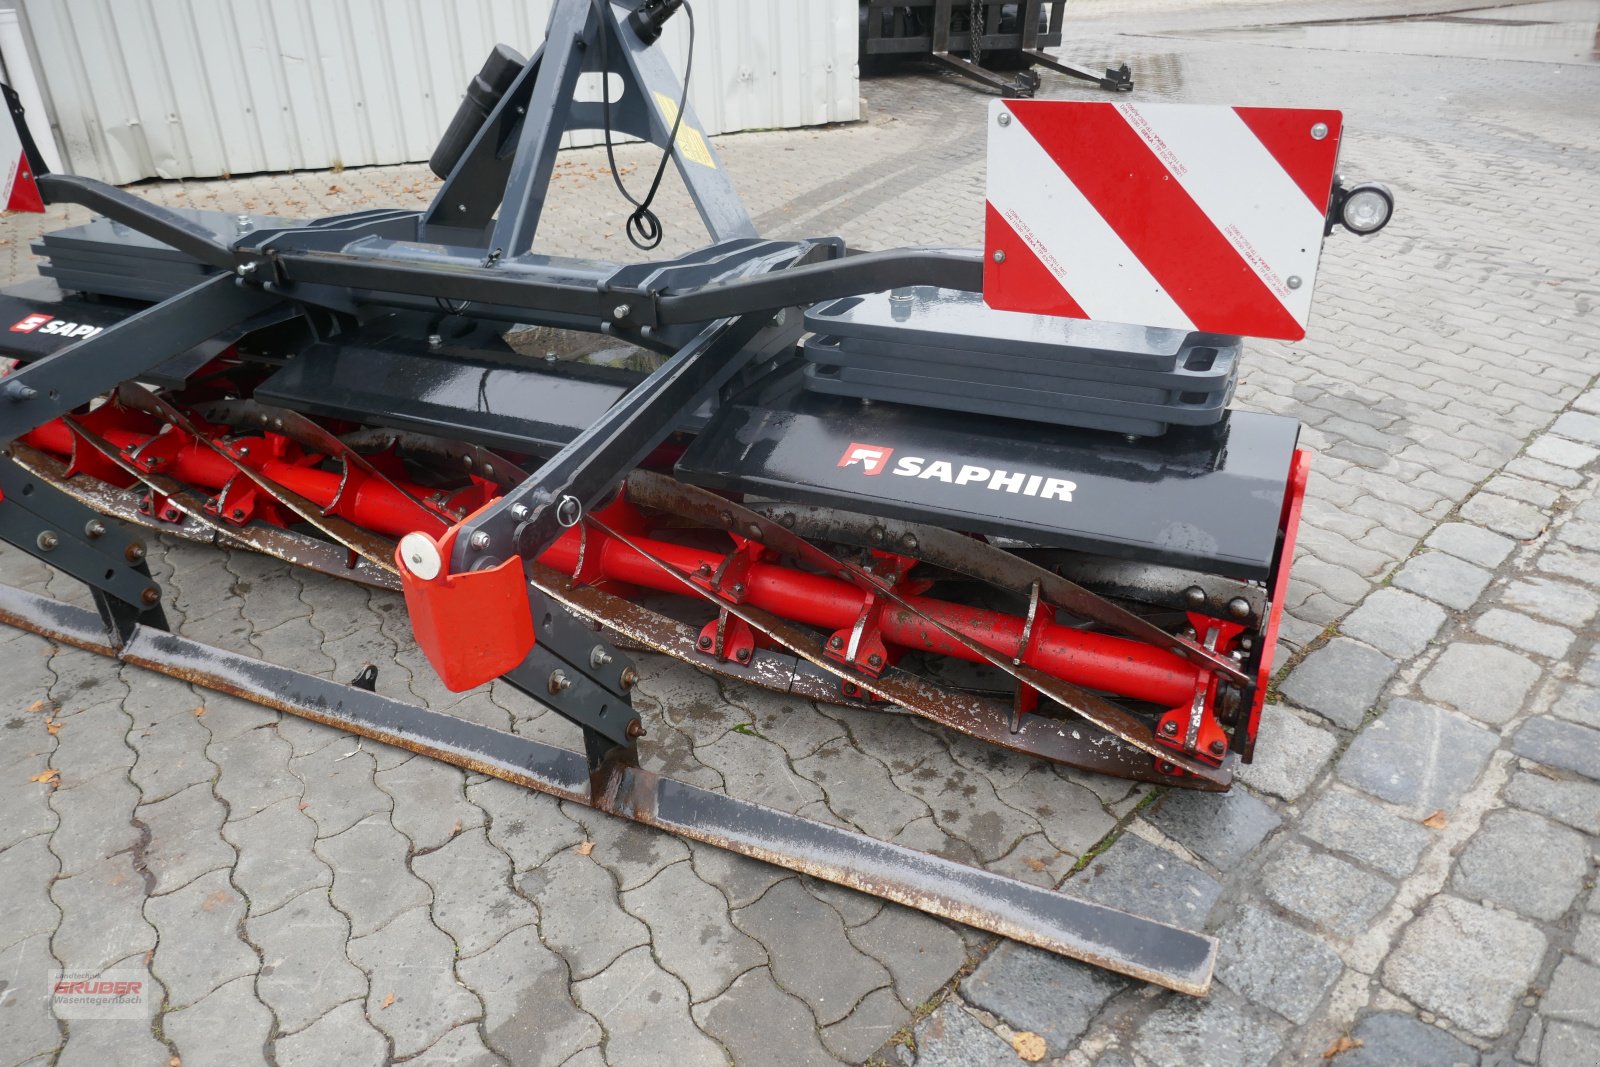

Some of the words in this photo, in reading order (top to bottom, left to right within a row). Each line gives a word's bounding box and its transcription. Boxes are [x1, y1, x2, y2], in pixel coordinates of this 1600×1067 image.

[1140, 128, 1154, 144] GEKA
[1153, 134, 1167, 150] GEKA
[1024, 234, 1036, 247] GEKA
[1035, 239, 1048, 253] GEKA
[1245, 251, 1258, 266] GEKA
[1257, 257, 1271, 272] GEKA
[892, 456, 1077, 503] SAPHIR
